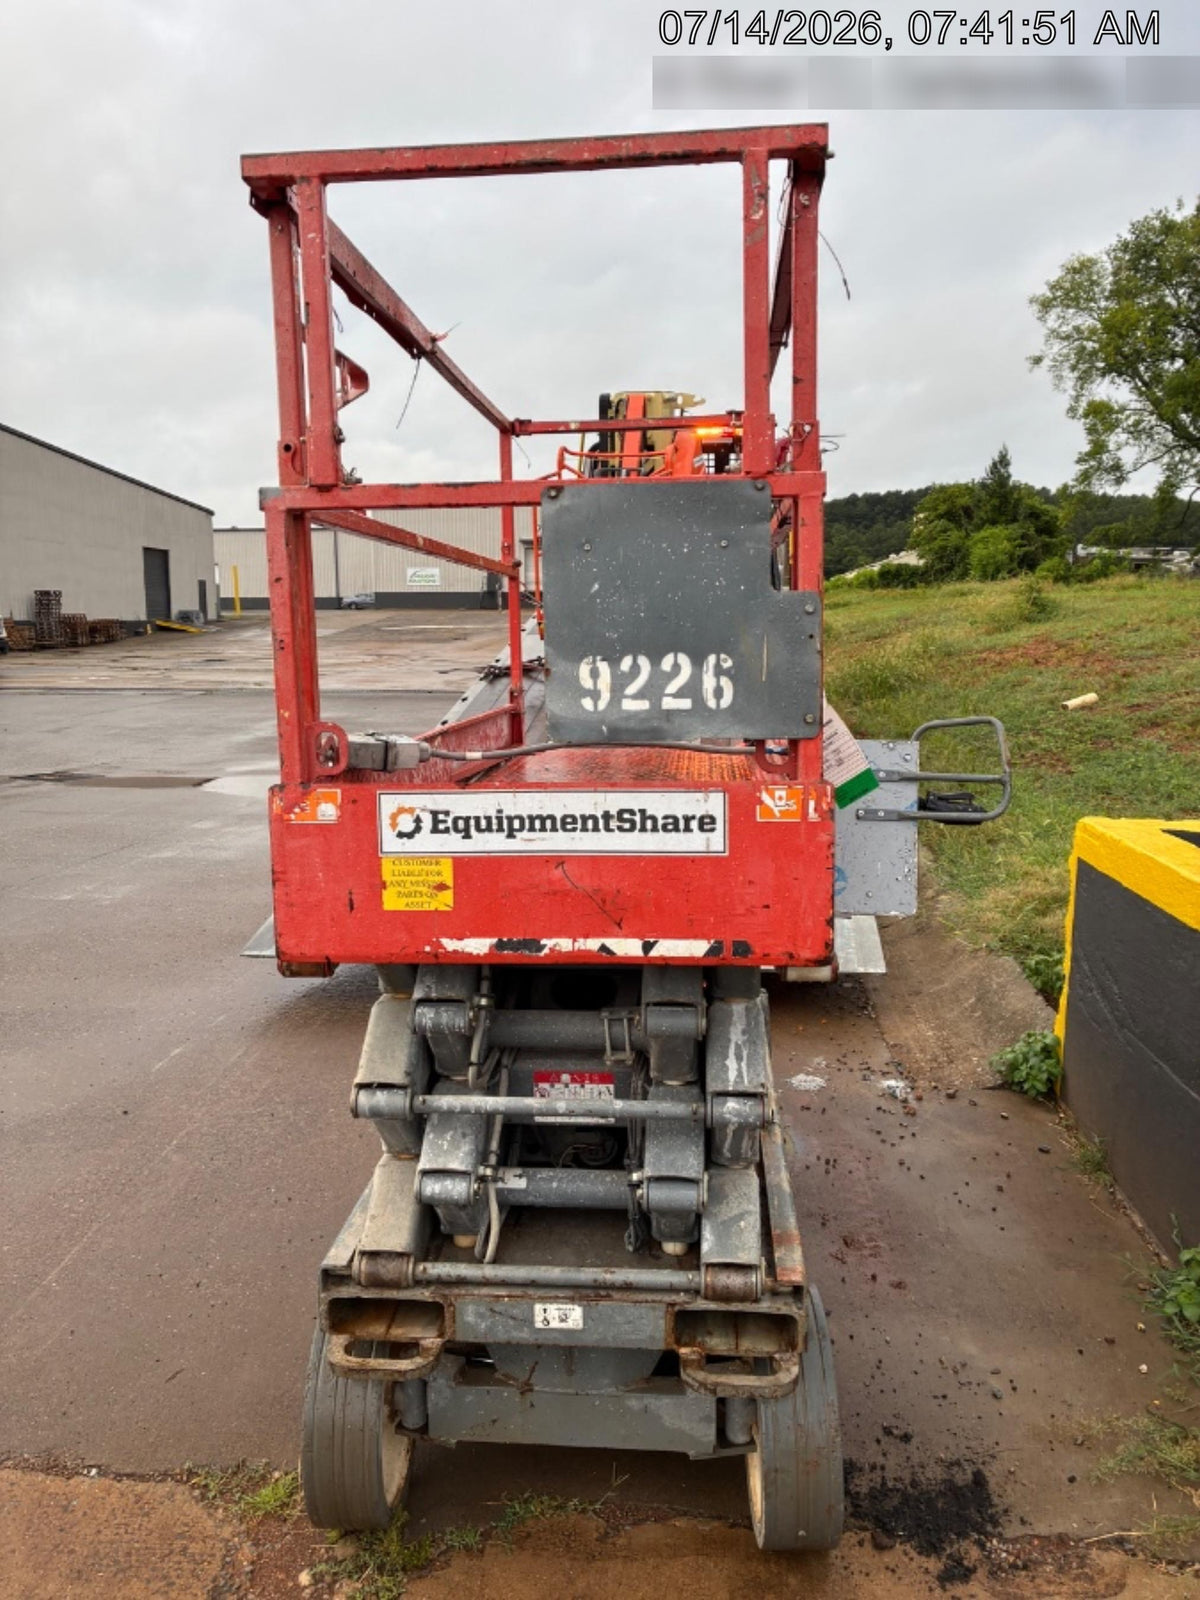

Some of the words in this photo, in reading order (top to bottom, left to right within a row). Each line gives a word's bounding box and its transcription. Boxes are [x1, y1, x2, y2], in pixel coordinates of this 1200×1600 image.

[578, 652, 734, 712] 9226
[429, 808, 717, 839] EquipmentShare
[392, 869, 422, 877] LIABLE
[425, 869, 444, 877] FOR
[389, 880, 407, 888] ANY
[396, 890, 424, 898] PARTS
